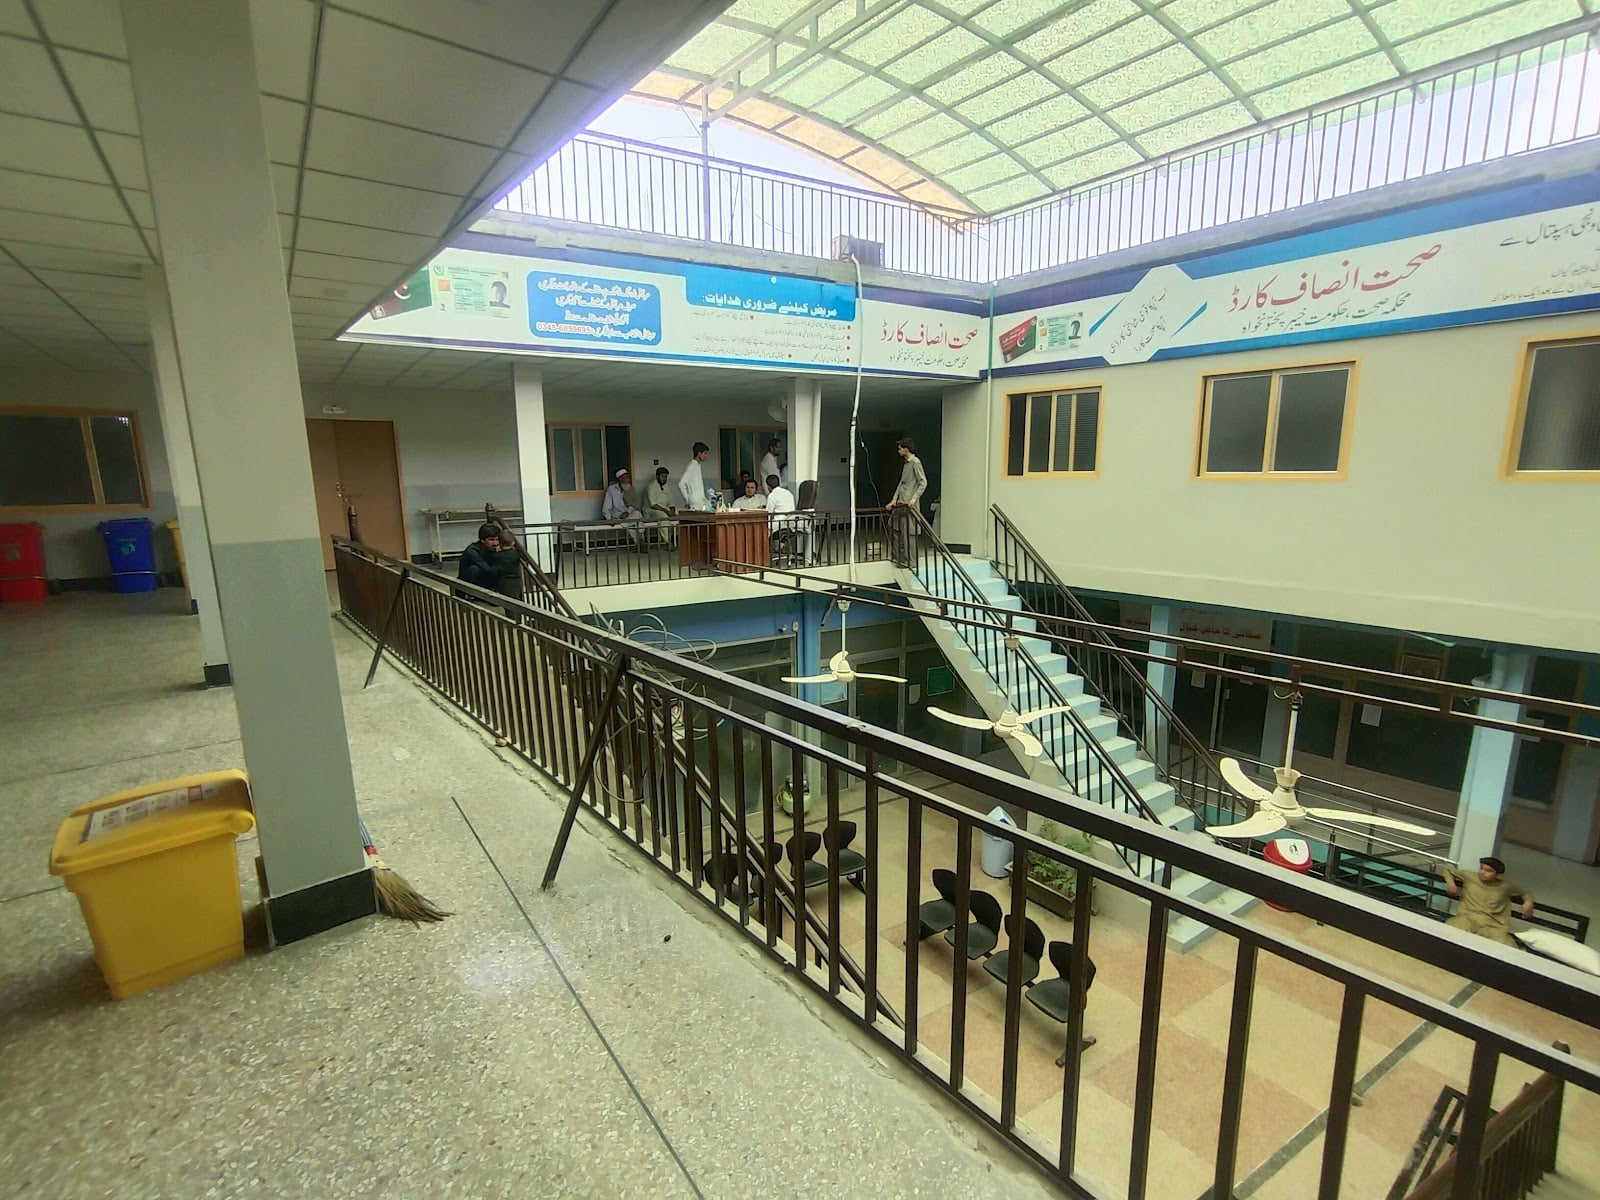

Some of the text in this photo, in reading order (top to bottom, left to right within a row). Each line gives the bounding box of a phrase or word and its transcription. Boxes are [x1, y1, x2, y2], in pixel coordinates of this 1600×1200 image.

[1500, 237, 1524, 247] سے
[1526, 222, 1573, 245] ہسپتال
[1227, 243, 1442, 313] صحت انصاف کارڈ
[742, 298, 777, 311] ضروری
[810, 306, 837, 317] مریض
[1305, 303, 1348, 326] حکومت
[1381, 292, 1411, 315] محکمہ
[880, 319, 909, 343] کارڈ
[1284, 307, 1306, 333] خیبر
[905, 323, 948, 346] انصاف
[948, 328, 978, 349] صحت
